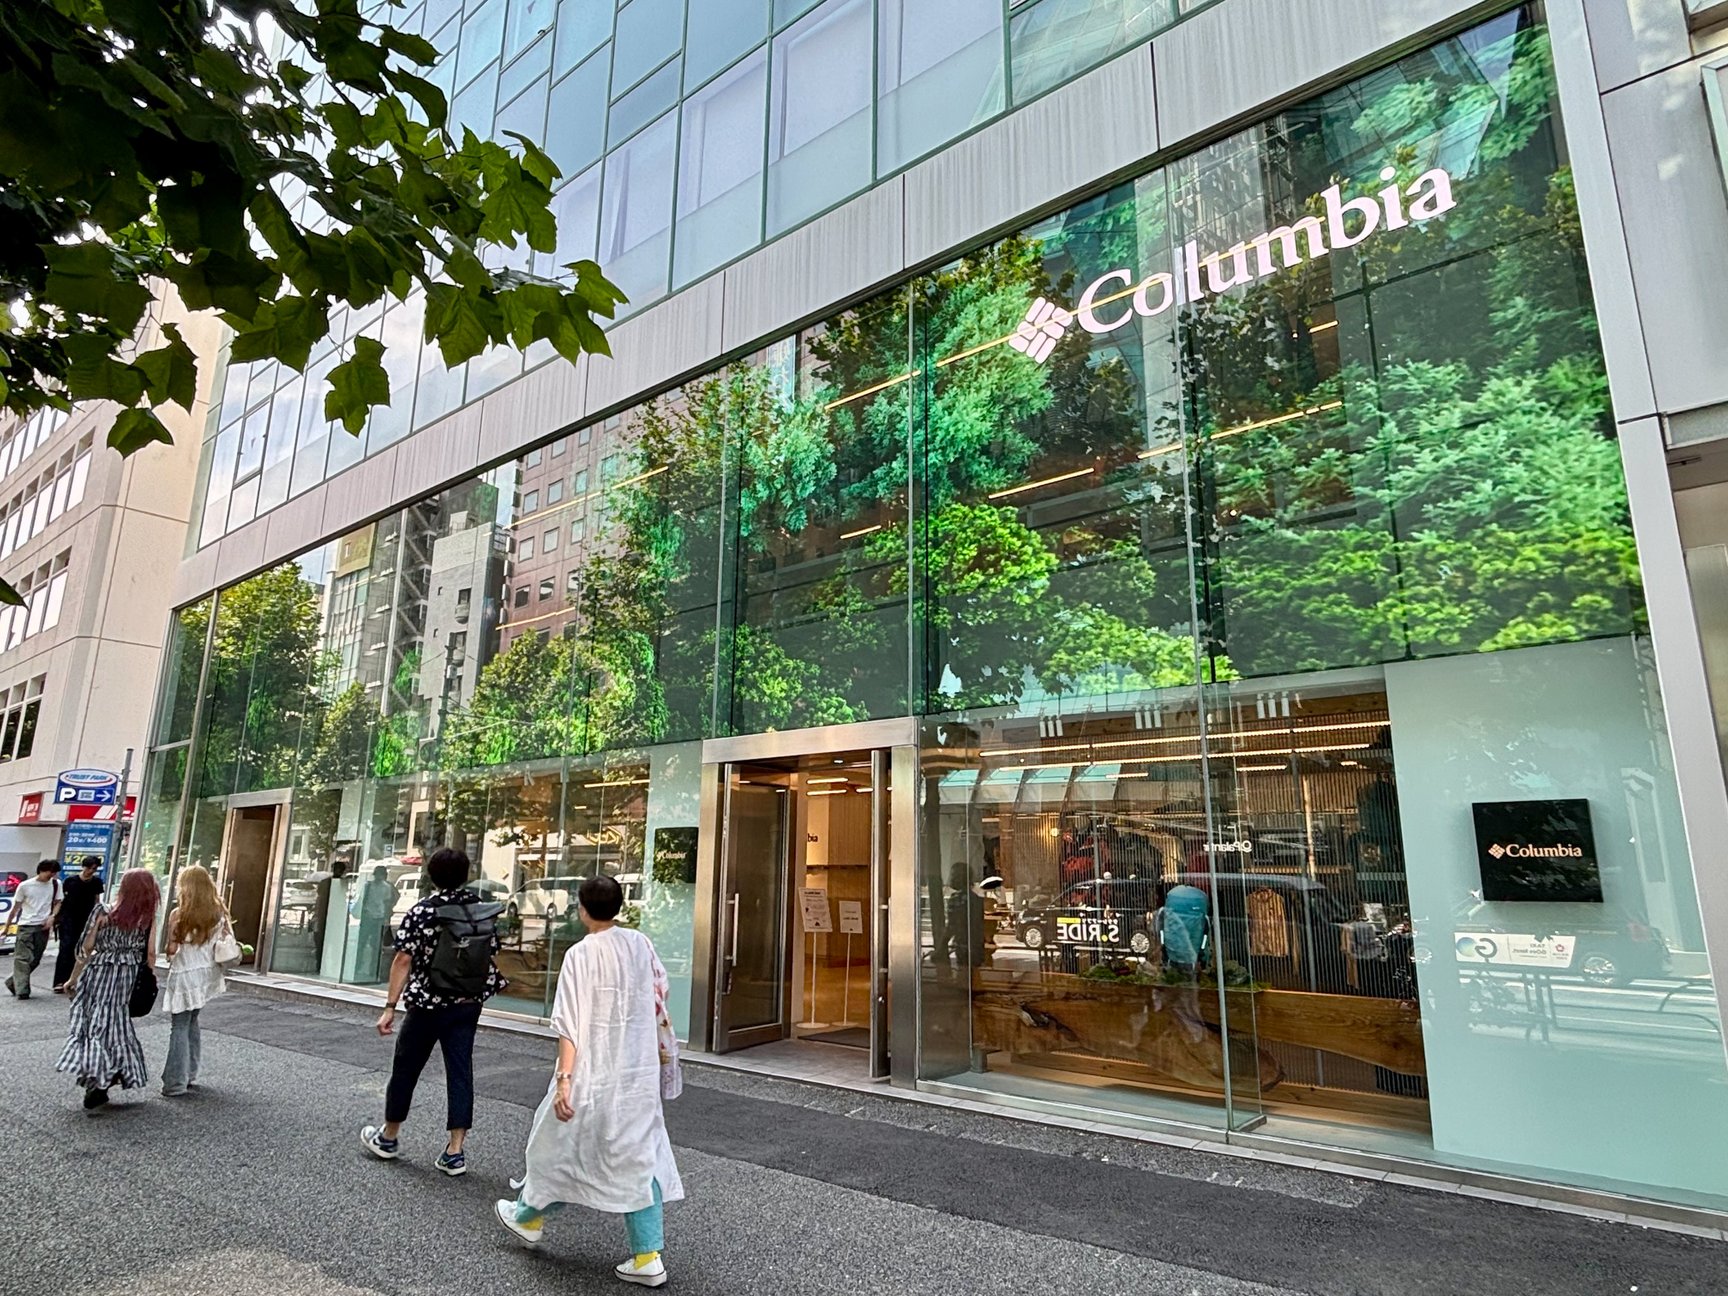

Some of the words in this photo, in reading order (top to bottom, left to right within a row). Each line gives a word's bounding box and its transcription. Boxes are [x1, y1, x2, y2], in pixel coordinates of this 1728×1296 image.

[1077, 165, 1457, 334] Columbia
[60, 787, 77, 802] P
[1505, 843, 1583, 858] Columbia
